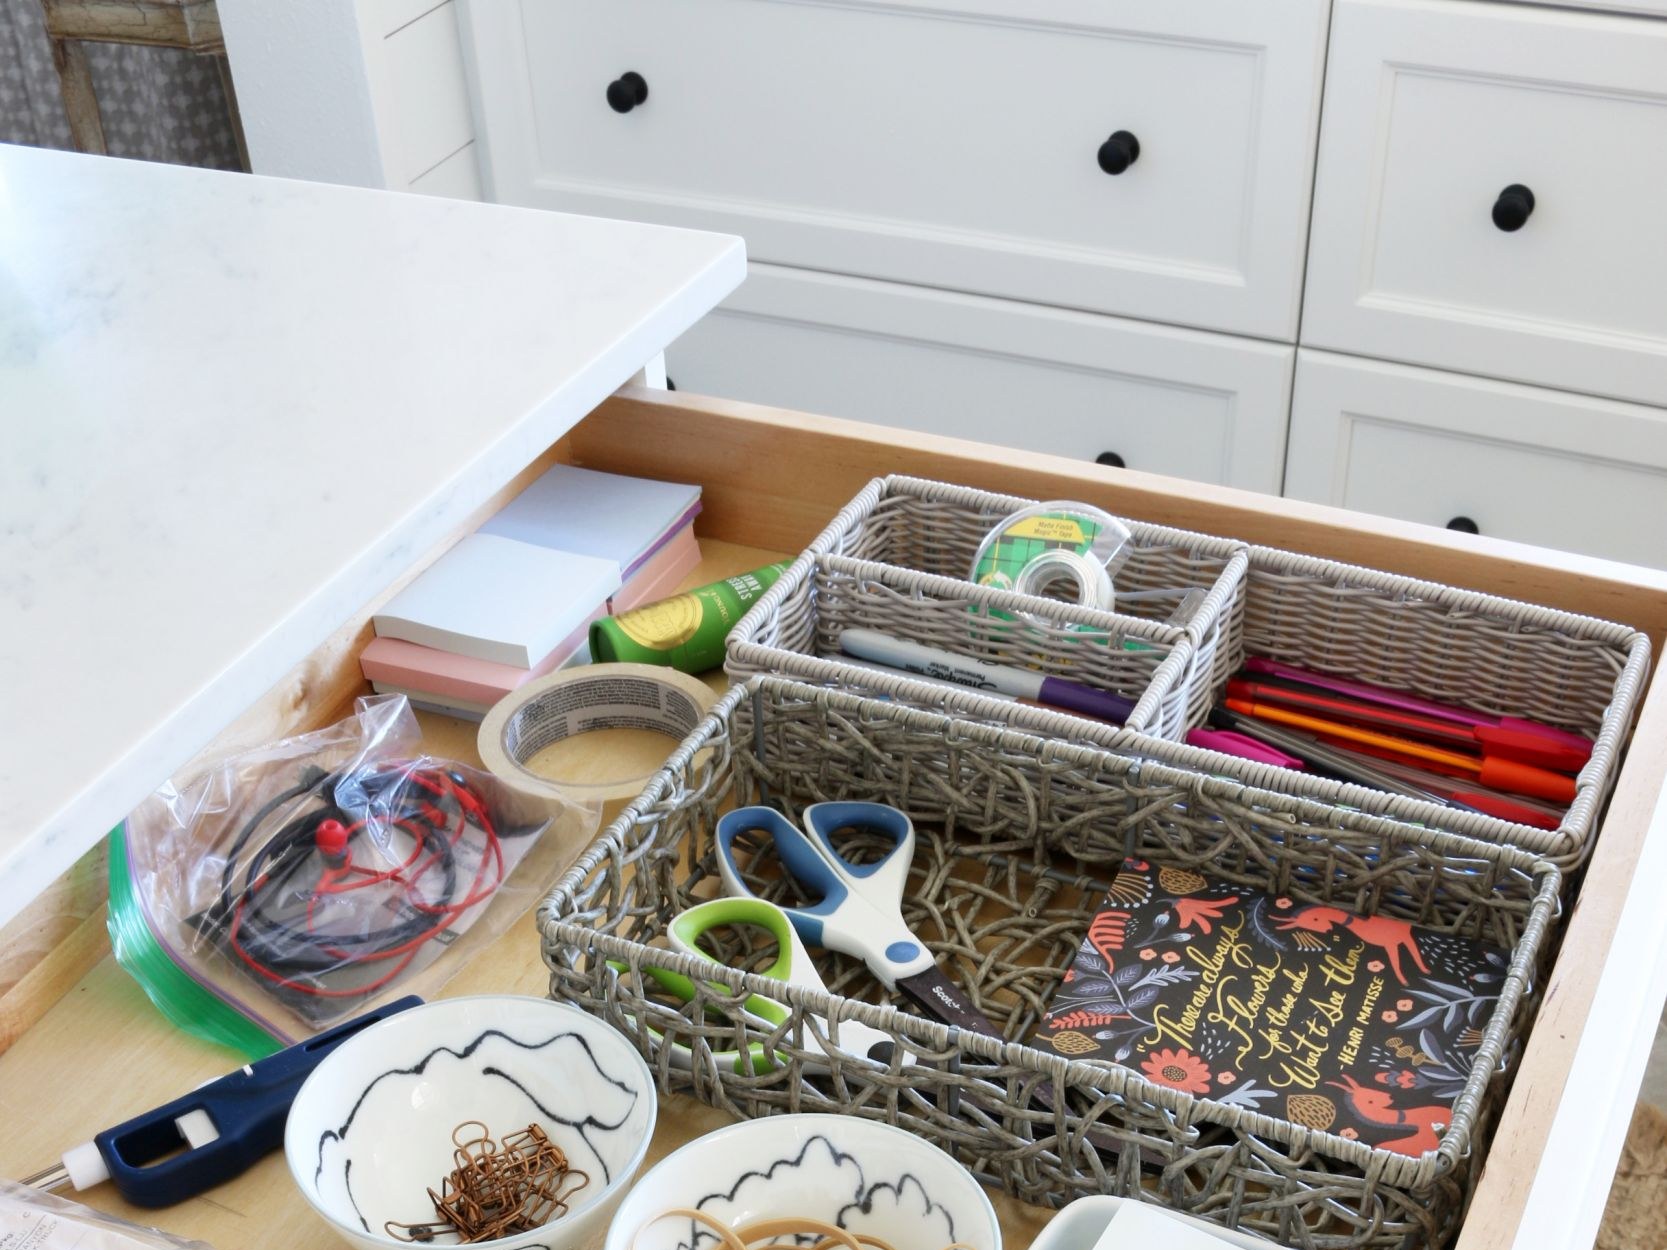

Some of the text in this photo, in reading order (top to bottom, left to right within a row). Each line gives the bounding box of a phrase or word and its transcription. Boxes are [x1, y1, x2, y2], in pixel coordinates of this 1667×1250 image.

[1186, 910, 1254, 983] always
[1193, 985, 1213, 1007] are
[1258, 962, 1309, 1060] for those who
[1356, 975, 1385, 1025] MATISSE
[1306, 1017, 1329, 1038] to
